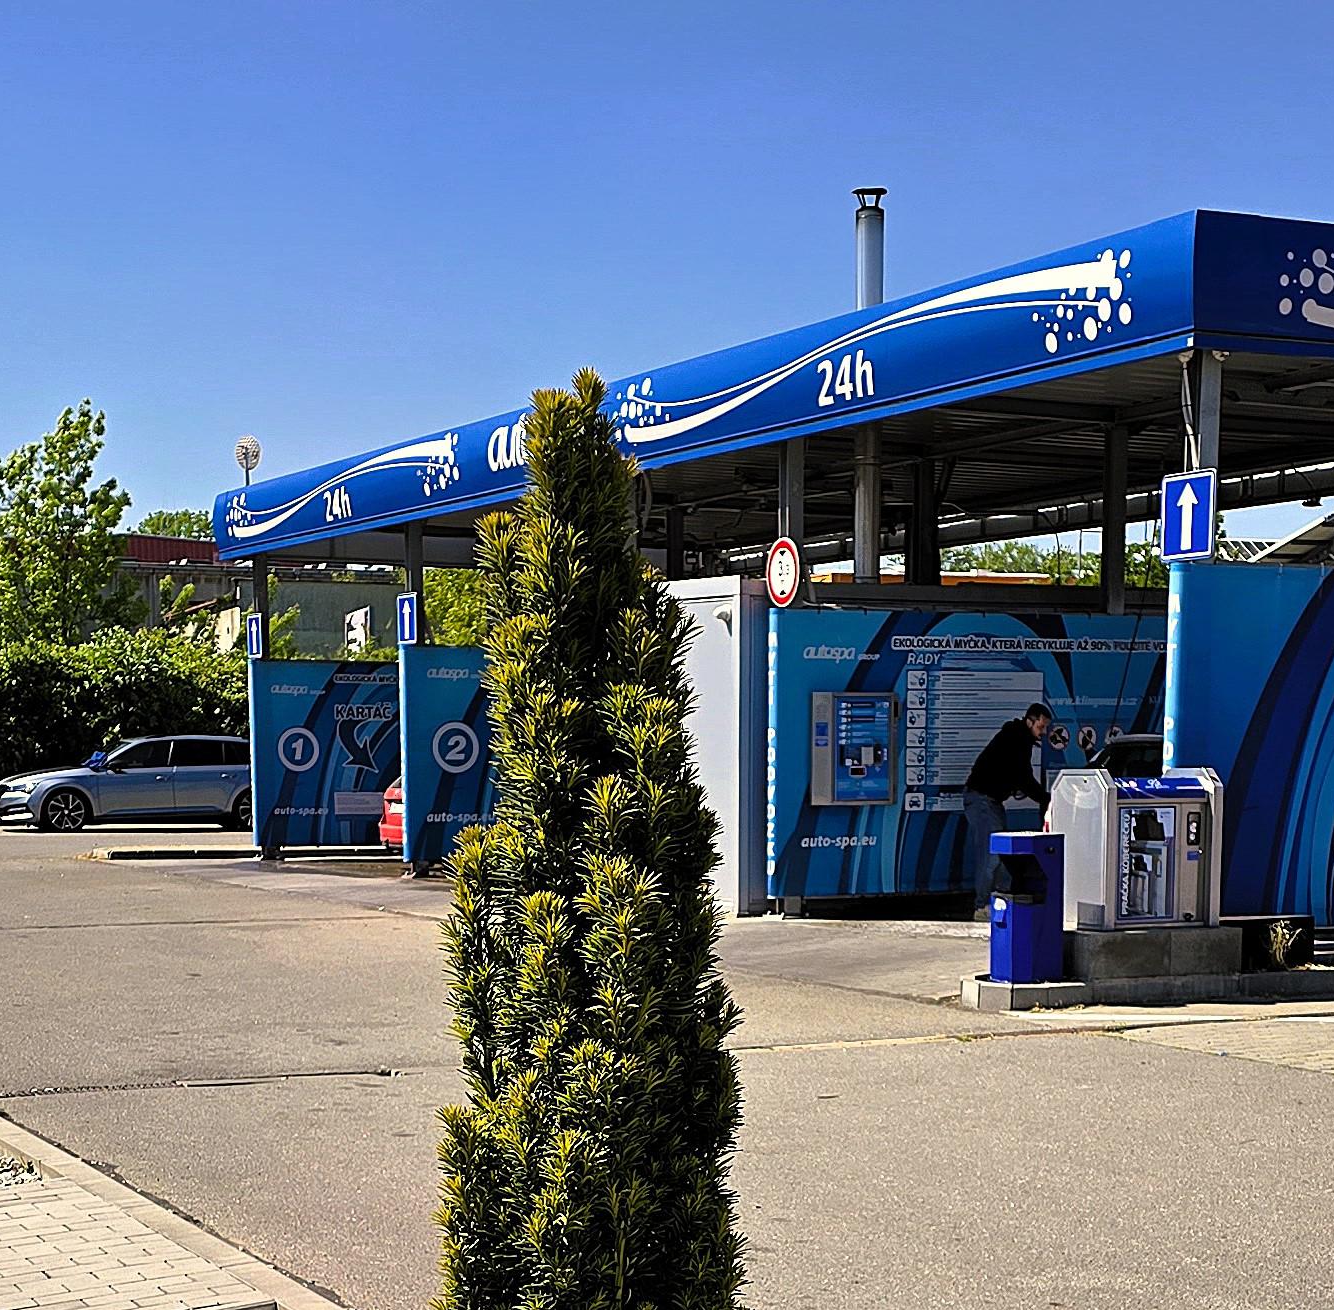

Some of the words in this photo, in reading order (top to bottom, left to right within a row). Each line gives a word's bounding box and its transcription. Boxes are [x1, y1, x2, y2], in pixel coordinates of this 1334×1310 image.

[817, 350, 874, 407] 24h
[322, 485, 353, 523] 24h
[893, 636, 951, 649] EKOLOGICKÁ
[991, 636, 1022, 650] KTERÁ
[803, 645, 856, 664] autospa
[907, 653, 941, 665] RADY
[427, 667, 469, 682] autospa
[270, 684, 308, 697] autospa
[335, 703, 393, 720] KARTÁČ
[291, 738, 304, 760] 1
[445, 735, 467, 761] 2
[274, 806, 329, 817] auto-spa.eu
[801, 835, 877, 849] auto-spa.eu
